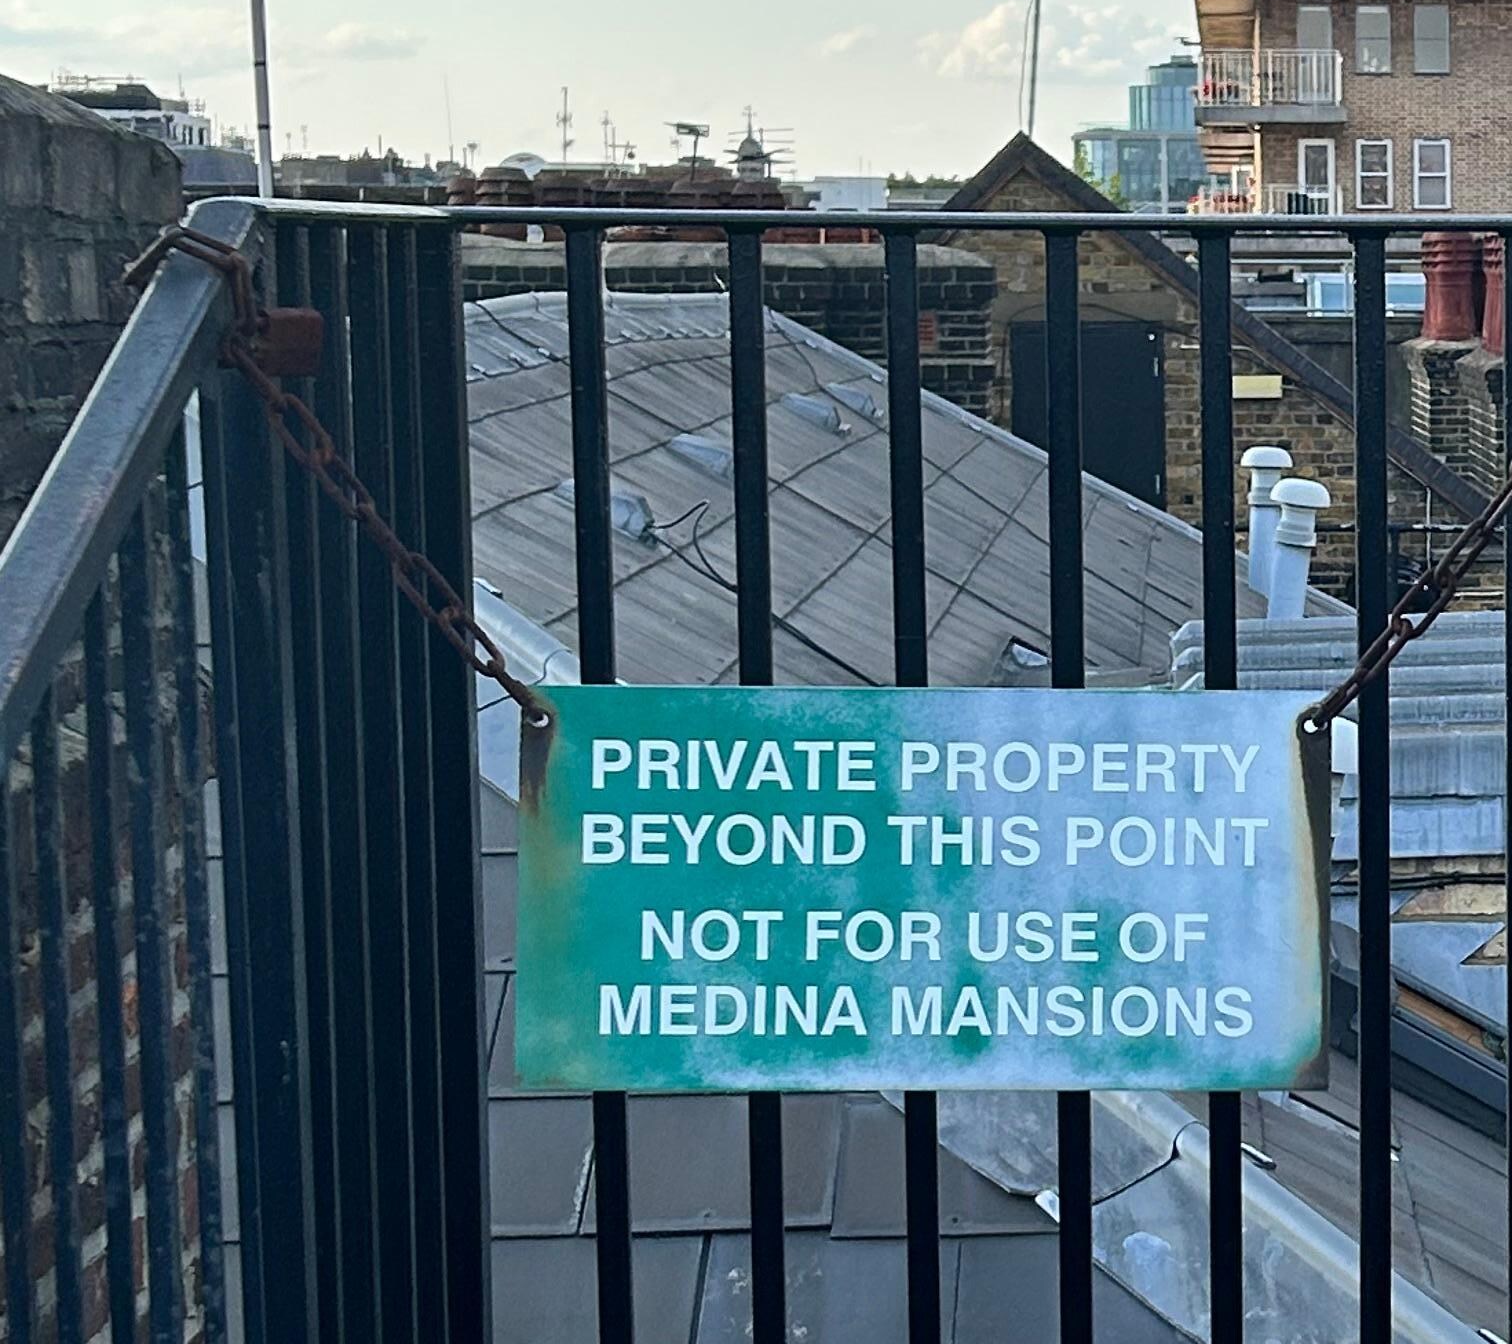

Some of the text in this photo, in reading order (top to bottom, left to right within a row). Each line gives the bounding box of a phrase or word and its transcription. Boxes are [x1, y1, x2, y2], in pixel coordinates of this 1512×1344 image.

[592, 739, 1260, 792] PRIVATE PROPERTY
[581, 813, 1269, 866] BEYOND THIS POINT
[641, 909, 1207, 962] NOT FOR USE OF
[598, 984, 1254, 1037] MEDINA MANSIONS
